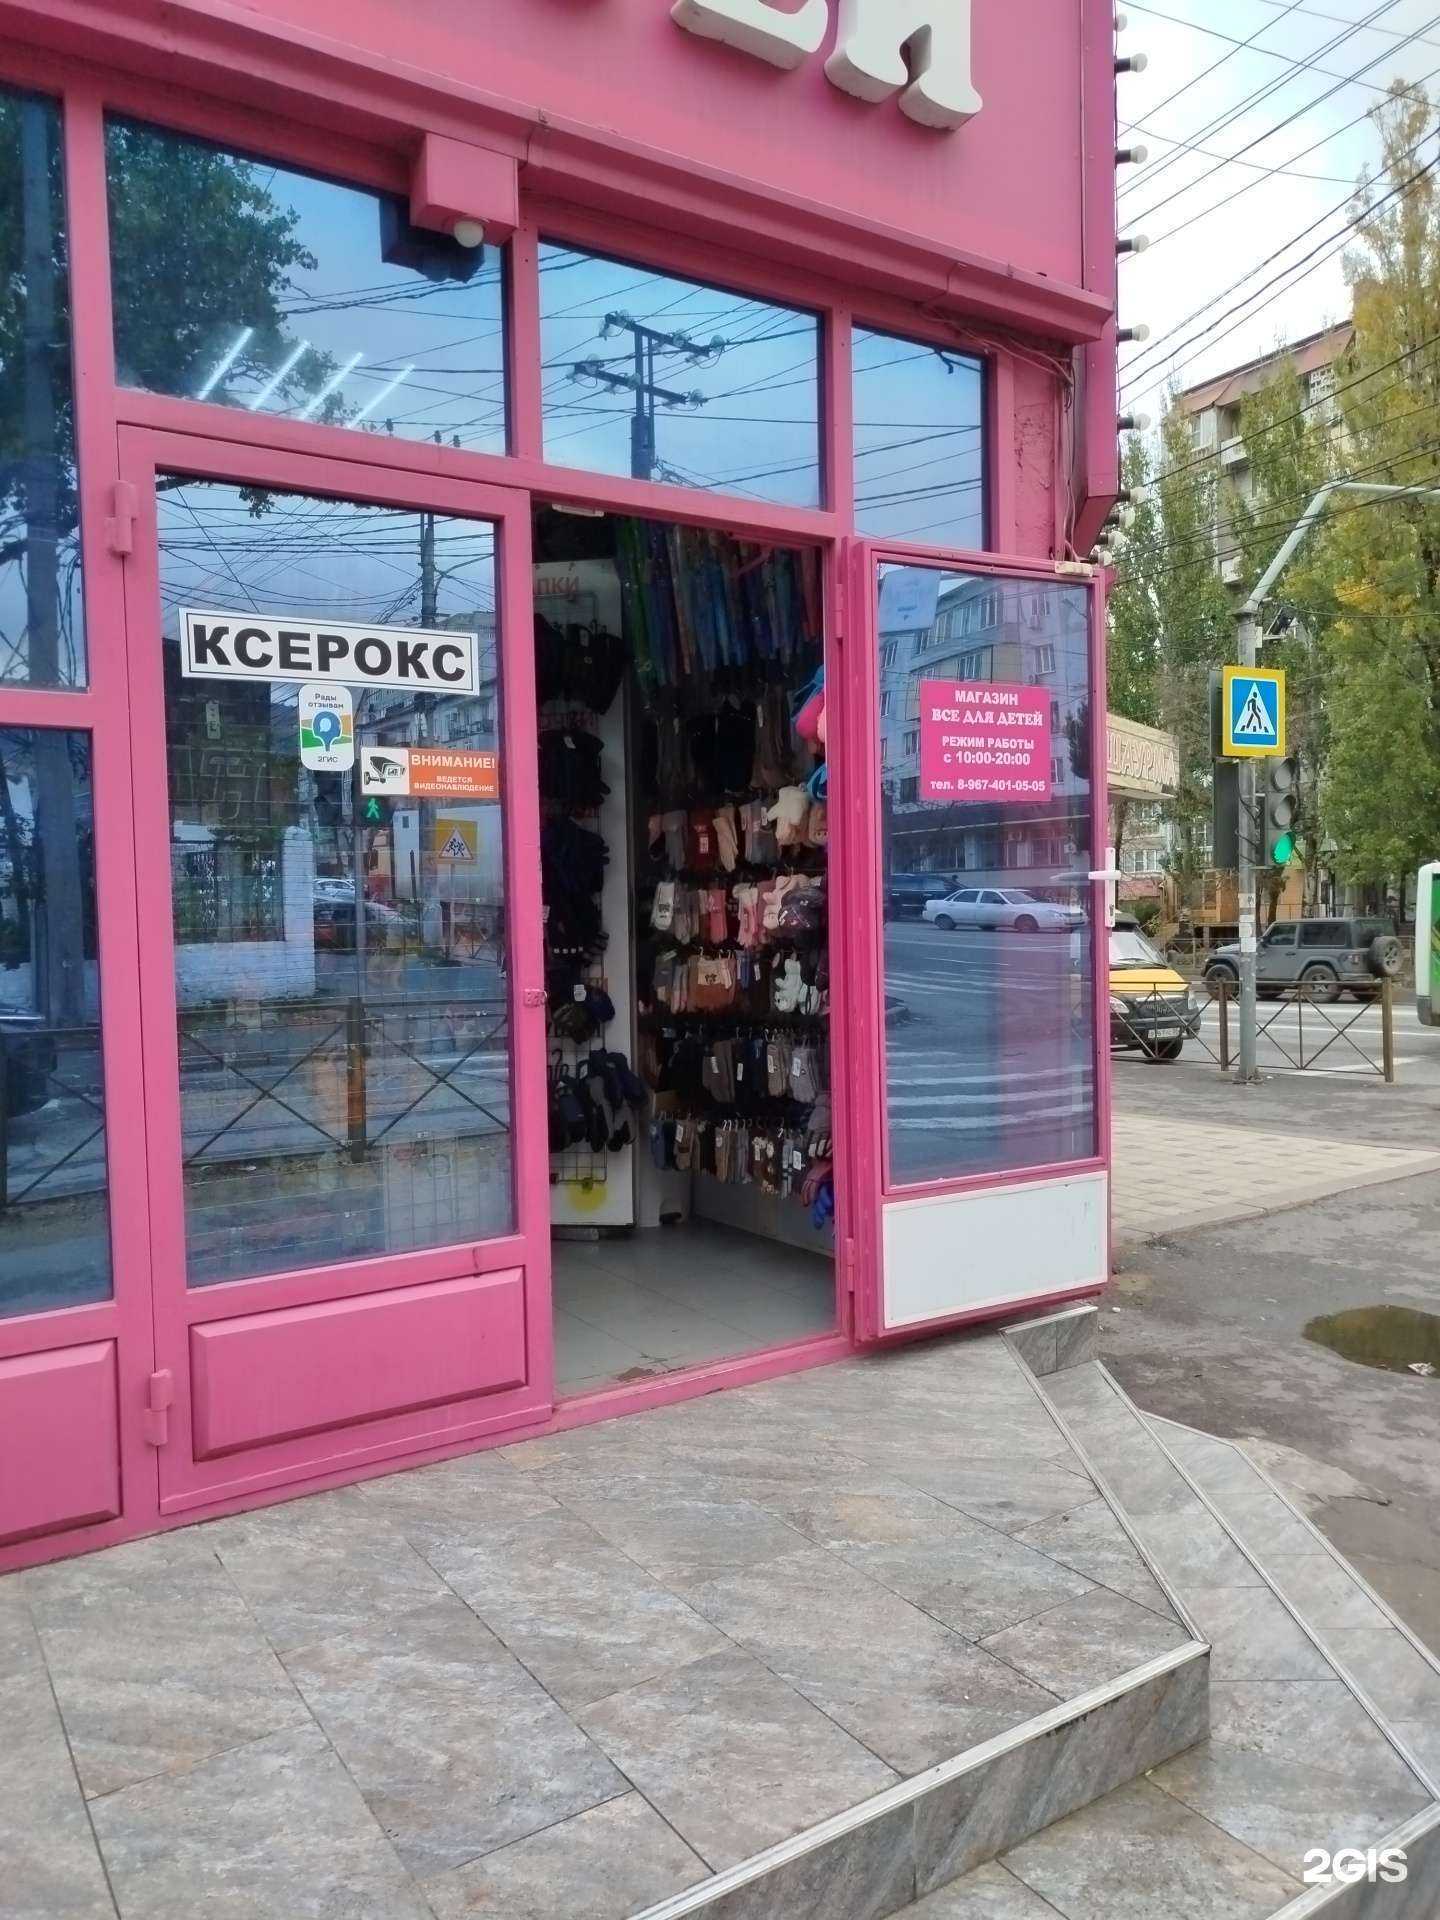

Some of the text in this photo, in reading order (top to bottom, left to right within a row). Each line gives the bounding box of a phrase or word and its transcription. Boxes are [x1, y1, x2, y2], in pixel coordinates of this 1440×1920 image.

[193, 624, 466, 682] КСЕРОКС
[315, 693, 337, 702] Рады
[955, 690, 1018, 706] МАГАЗИН
[308, 701, 344, 710] отзывам
[932, 709, 1043, 727] ВСЕ ДЛЯ ДЕТЕЙ
[942, 736, 1034, 750] РЕЖИМ РАБОТЫ
[317, 755, 338, 764] 2ГИС
[411, 754, 496, 769] ВНИМАНИЕ!
[956, 751, 1031, 765] 10:00-20:00
[436, 775, 473, 784] ВЕДЕТСЯ
[930, 779, 1046, 792] тел. 8-967-401-05-05
[414, 782, 496, 793] ВИДЕОНАБЛЮДЕНИЕ
